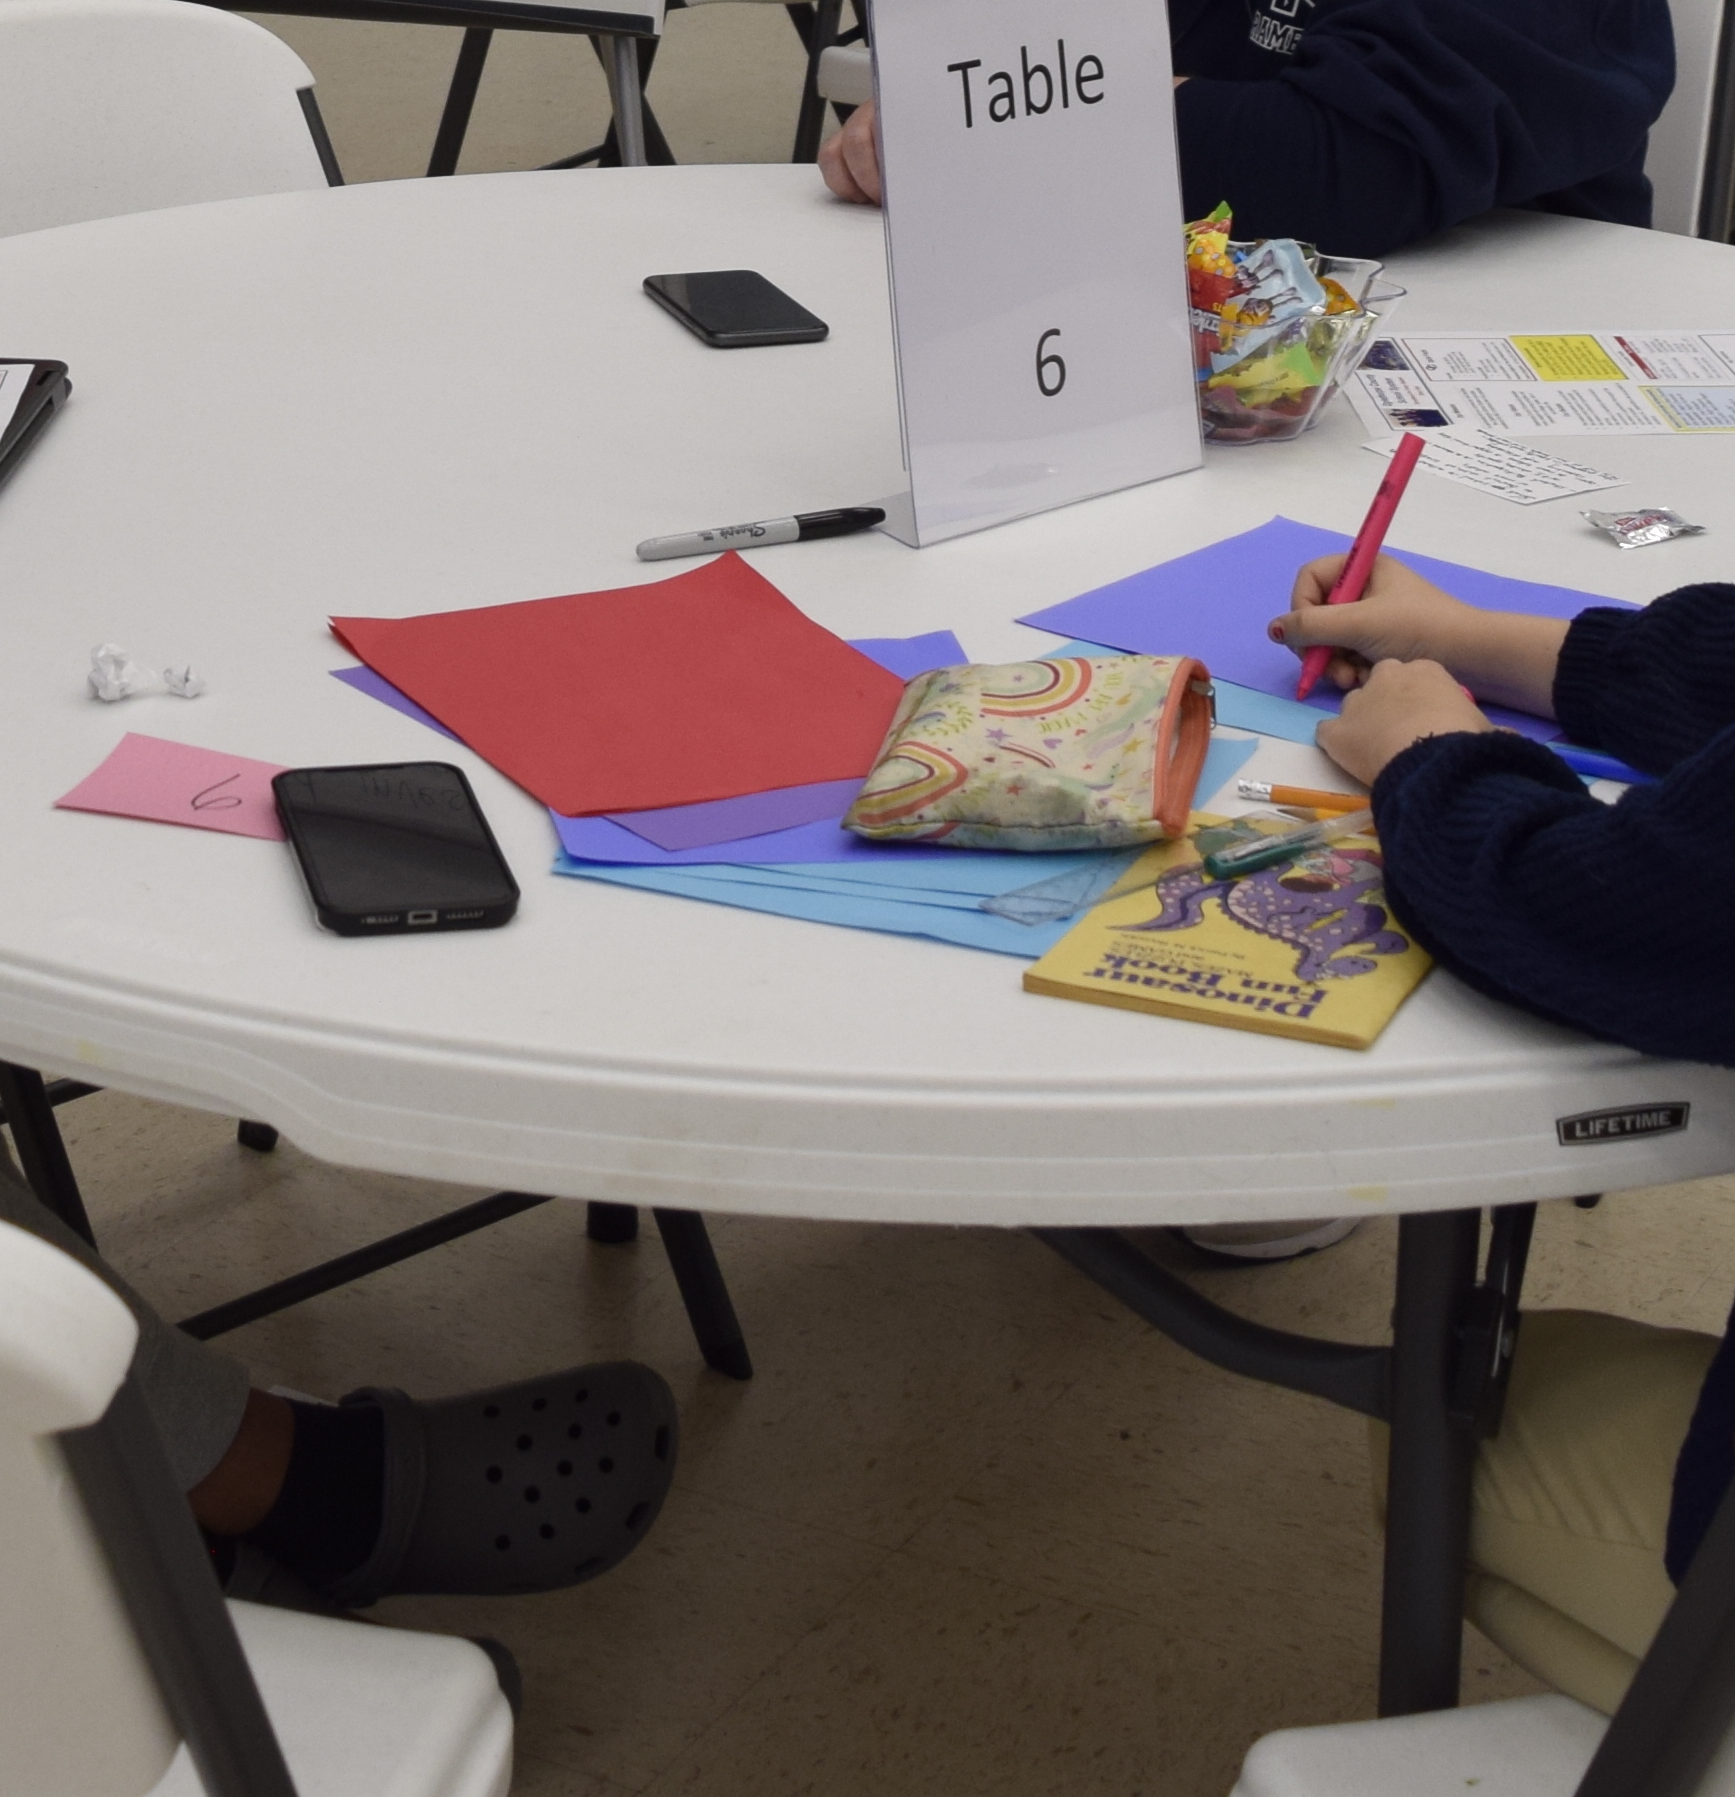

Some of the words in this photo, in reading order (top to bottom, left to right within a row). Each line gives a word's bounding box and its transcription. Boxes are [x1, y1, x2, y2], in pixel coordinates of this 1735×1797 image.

[947, 39, 1107, 130] Table
[1033, 328, 1067, 398] 6
[1102, 953, 1225, 987] Book
[1239, 978, 1329, 1005] Fun
[1083, 966, 1315, 1020] Dinosaur
[1574, 1110, 1672, 1139] LIFETIME
